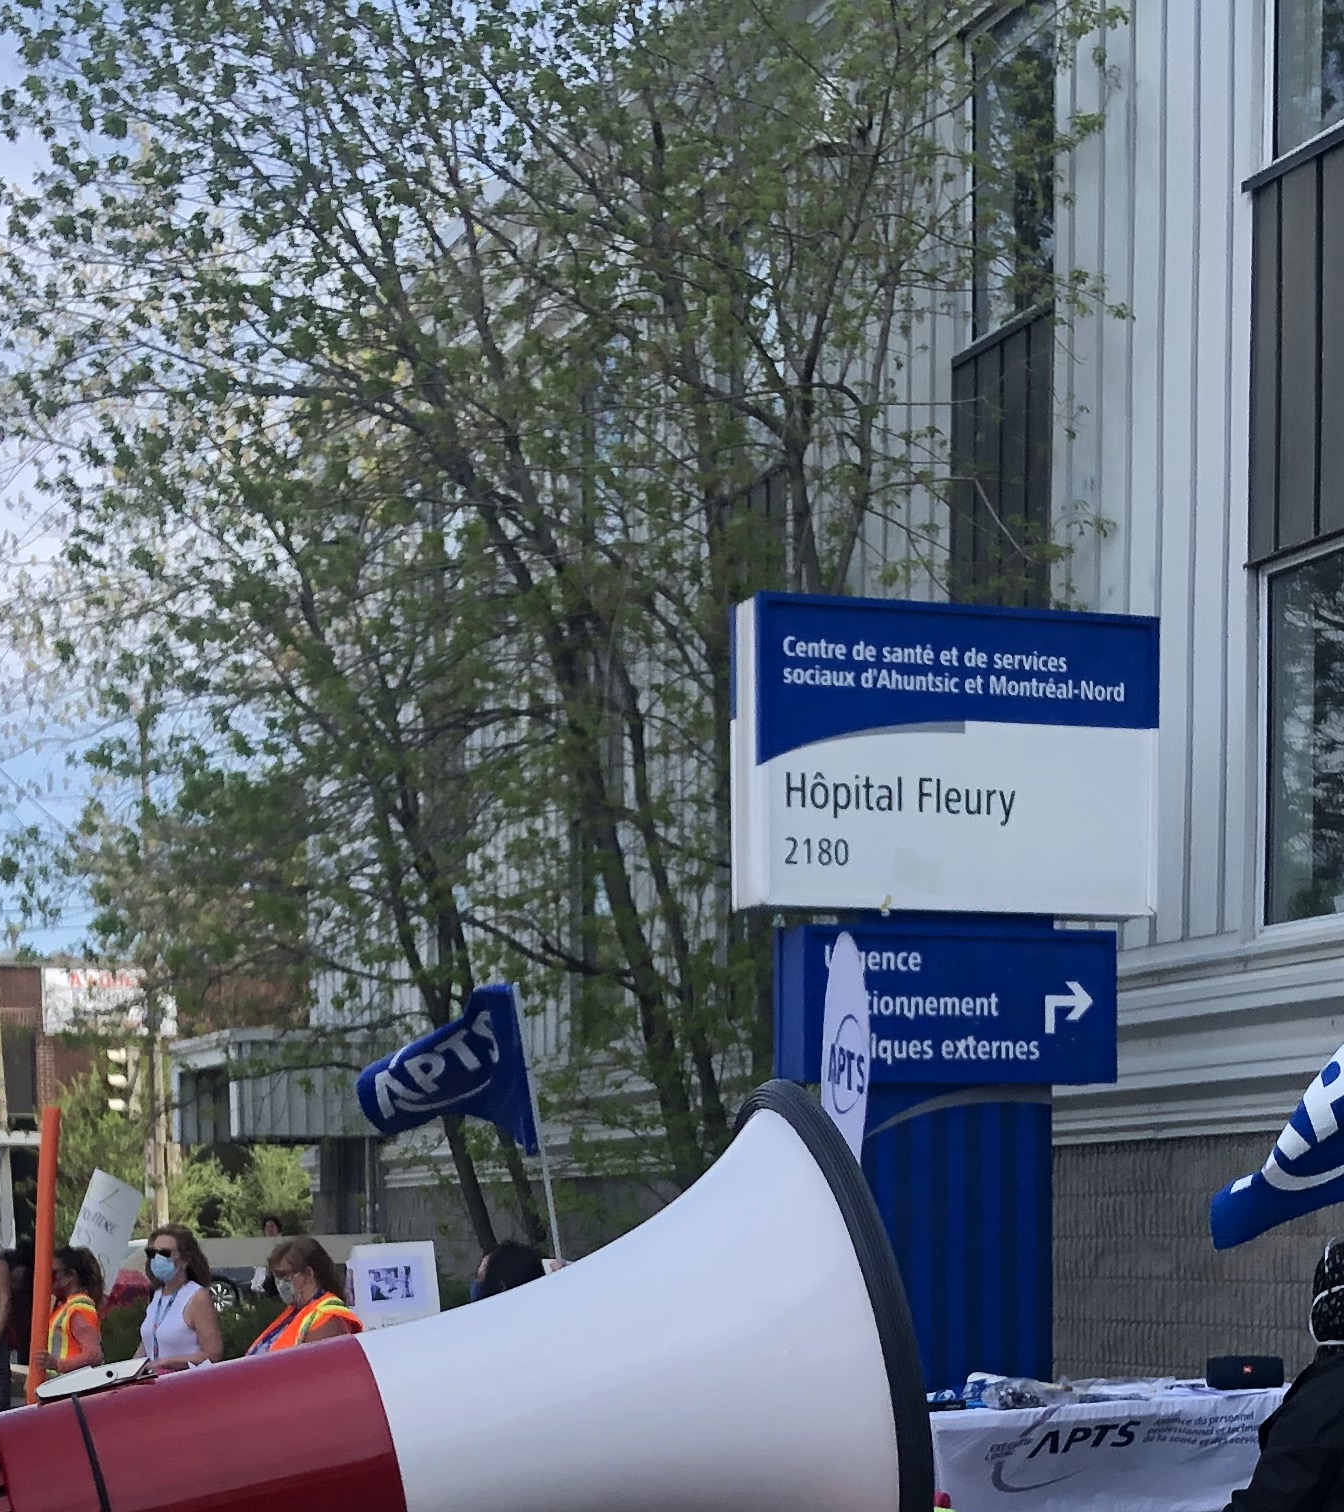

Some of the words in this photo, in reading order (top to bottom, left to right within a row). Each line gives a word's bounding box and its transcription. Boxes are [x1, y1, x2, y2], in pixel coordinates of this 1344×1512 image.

[782, 635, 847, 660] Centre
[852, 640, 877, 662] de
[882, 643, 935, 666] santé
[939, 646, 960, 667] et
[963, 647, 988, 668] de
[993, 650, 1068, 673] services
[782, 664, 855, 687] sociaux
[860, 668, 960, 694] d'Ahuntsic
[964, 674, 984, 695] et
[989, 674, 1125, 702] Montréal-Nord
[784, 770, 903, 819] Hôpital
[917, 776, 1016, 827] Fleury
[784, 836, 850, 866] 2180
[374, 1010, 500, 1119] APTS
[941, 1036, 1041, 1061] externes
[828, 1042, 866, 1096] APTS
[1027, 1420, 1141, 1459] APTS
